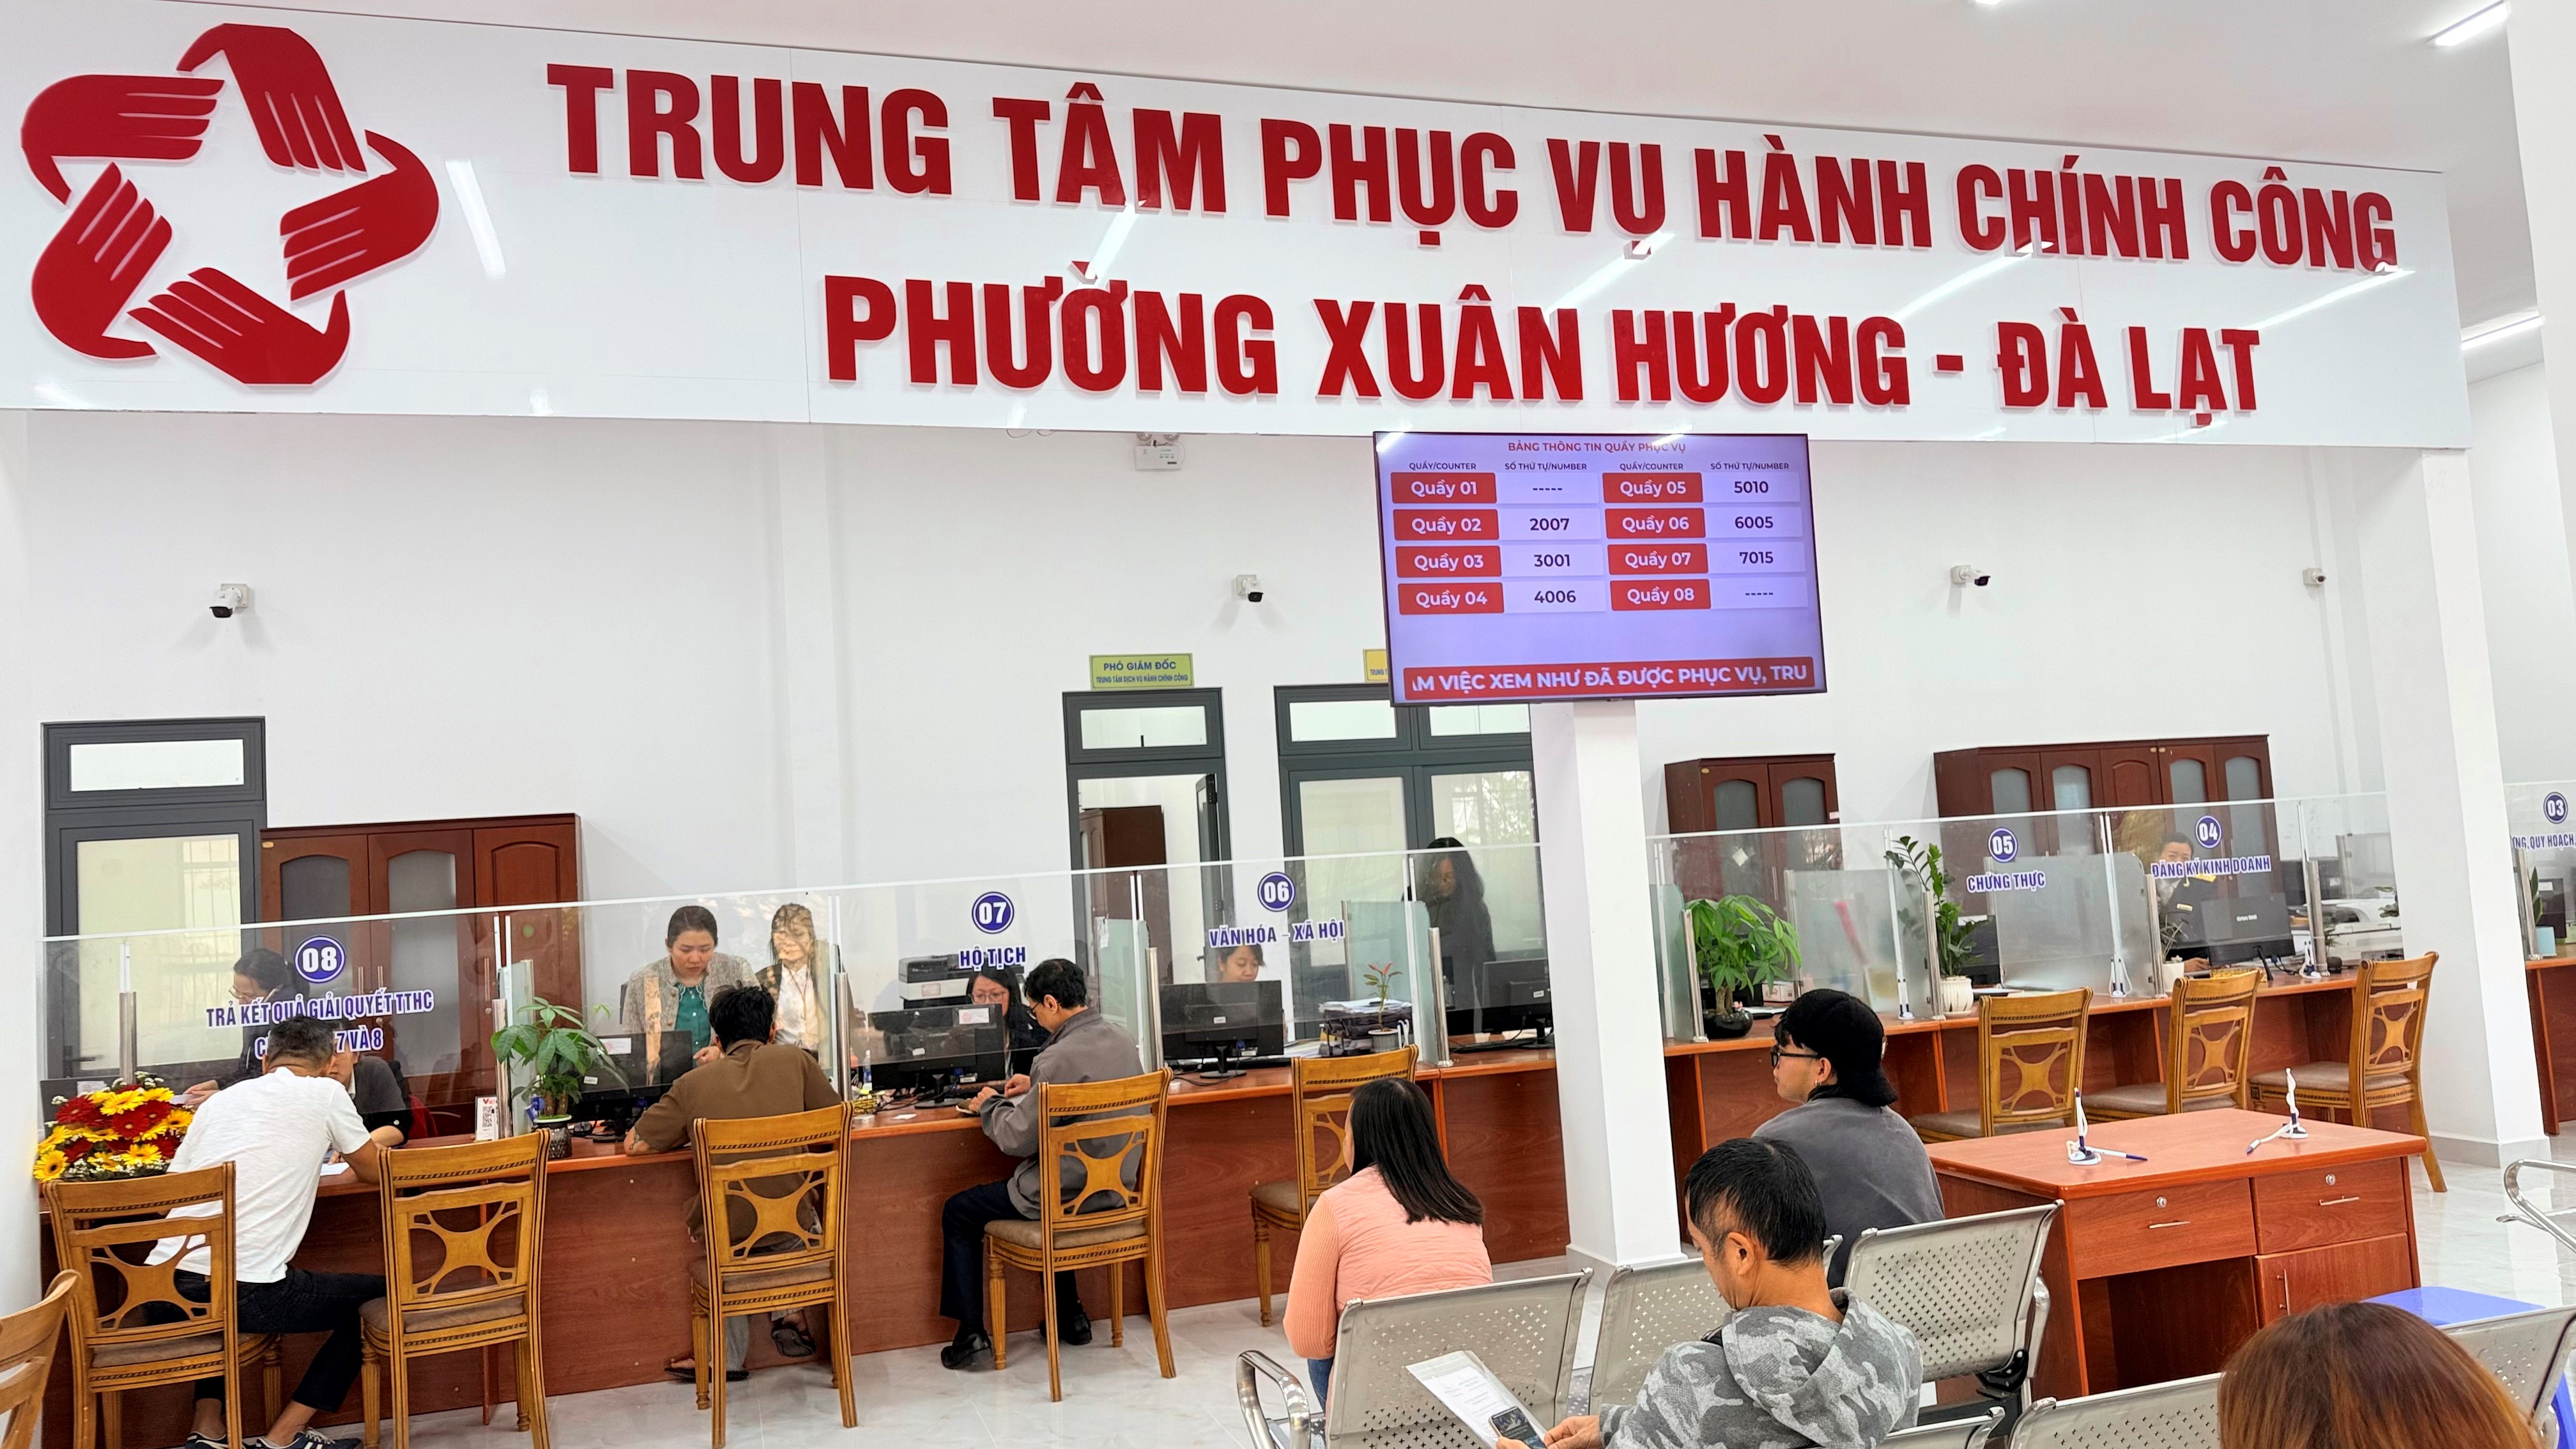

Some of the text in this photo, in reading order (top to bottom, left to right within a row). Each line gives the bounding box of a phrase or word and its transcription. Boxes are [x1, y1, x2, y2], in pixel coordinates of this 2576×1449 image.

[548, 65, 2397, 272] TRUNG TÂM PHỤC VỤ HÀNH CHÍNH CÔNG
[825, 261, 2260, 427] PHƯỜNG XUÂN HƯƠNG - ĐÀ LẠT
[1508, 440, 1540, 451] BẢNG
[1542, 441, 1581, 451] THÔNG
[1584, 442, 1602, 451] TIN
[1671, 442, 1686, 454] VỤ
[1505, 461, 1516, 470] SỐ
[1538, 462, 1588, 471] TỰ/NUMBER
[1710, 461, 1721, 470] SỐ
[1742, 462, 1790, 471] TỰ/NUMBER
[1411, 479, 1477, 498] Quầy 01
[1620, 479, 1687, 498] Quầy 05
[1734, 481, 1769, 494] 5010
[1411, 516, 1482, 535] Quầy 02
[1529, 518, 1570, 531] 2007
[1622, 515, 1690, 533] Quầy 06
[1735, 516, 1774, 529] 6005
[1414, 553, 1484, 572] Quầy 03
[1533, 554, 1570, 567] 3001
[1625, 550, 1691, 569] Quầy 07
[1739, 551, 1774, 564] 7015
[1415, 590, 1488, 608] Quầy 04
[1534, 590, 1576, 603] 4006
[1627, 586, 1695, 604] Quầy 08
[1104, 658, 1177, 671] PHÓ GIÁM ĐỐC
[1439, 671, 1485, 694] VIỆC
[1489, 673, 1532, 689] XEM
[1537, 669, 1581, 687] NHƯ
[1584, 666, 1614, 687] ĐÃ
[1618, 666, 1674, 688] ĐƯỢC
[1678, 667, 1732, 687] PHỤC
[1734, 666, 1767, 685] VỤ,
[1770, 665, 1807, 680] TRU
[2547, 799, 2564, 817] 03
[2198, 822, 2218, 842] 04
[1992, 835, 2013, 855] 05
[2530, 835, 2545, 850] QUY
[2152, 860, 2183, 877] ĐĂNG
[2204, 860, 2230, 875] KINH
[2233, 857, 2270, 872] DOANH
[1968, 871, 2044, 891] CHỨNG THỰC
[1264, 881, 1289, 903] 06
[979, 901, 1007, 924] 07
[1209, 927, 1241, 946] VĂN
[1246, 924, 1276, 944] HÓA
[1294, 921, 1314, 940] XÃ
[1319, 919, 1344, 941] HỘI
[302, 946, 338, 974] 08
[960, 946, 1026, 969] HỘ TỊCH
[206, 989, 432, 1027] TRẢ KẾT QUẢ GIẢI QUYẾT TTHC
[337, 1027, 381, 1051] 7 VÀ 8
